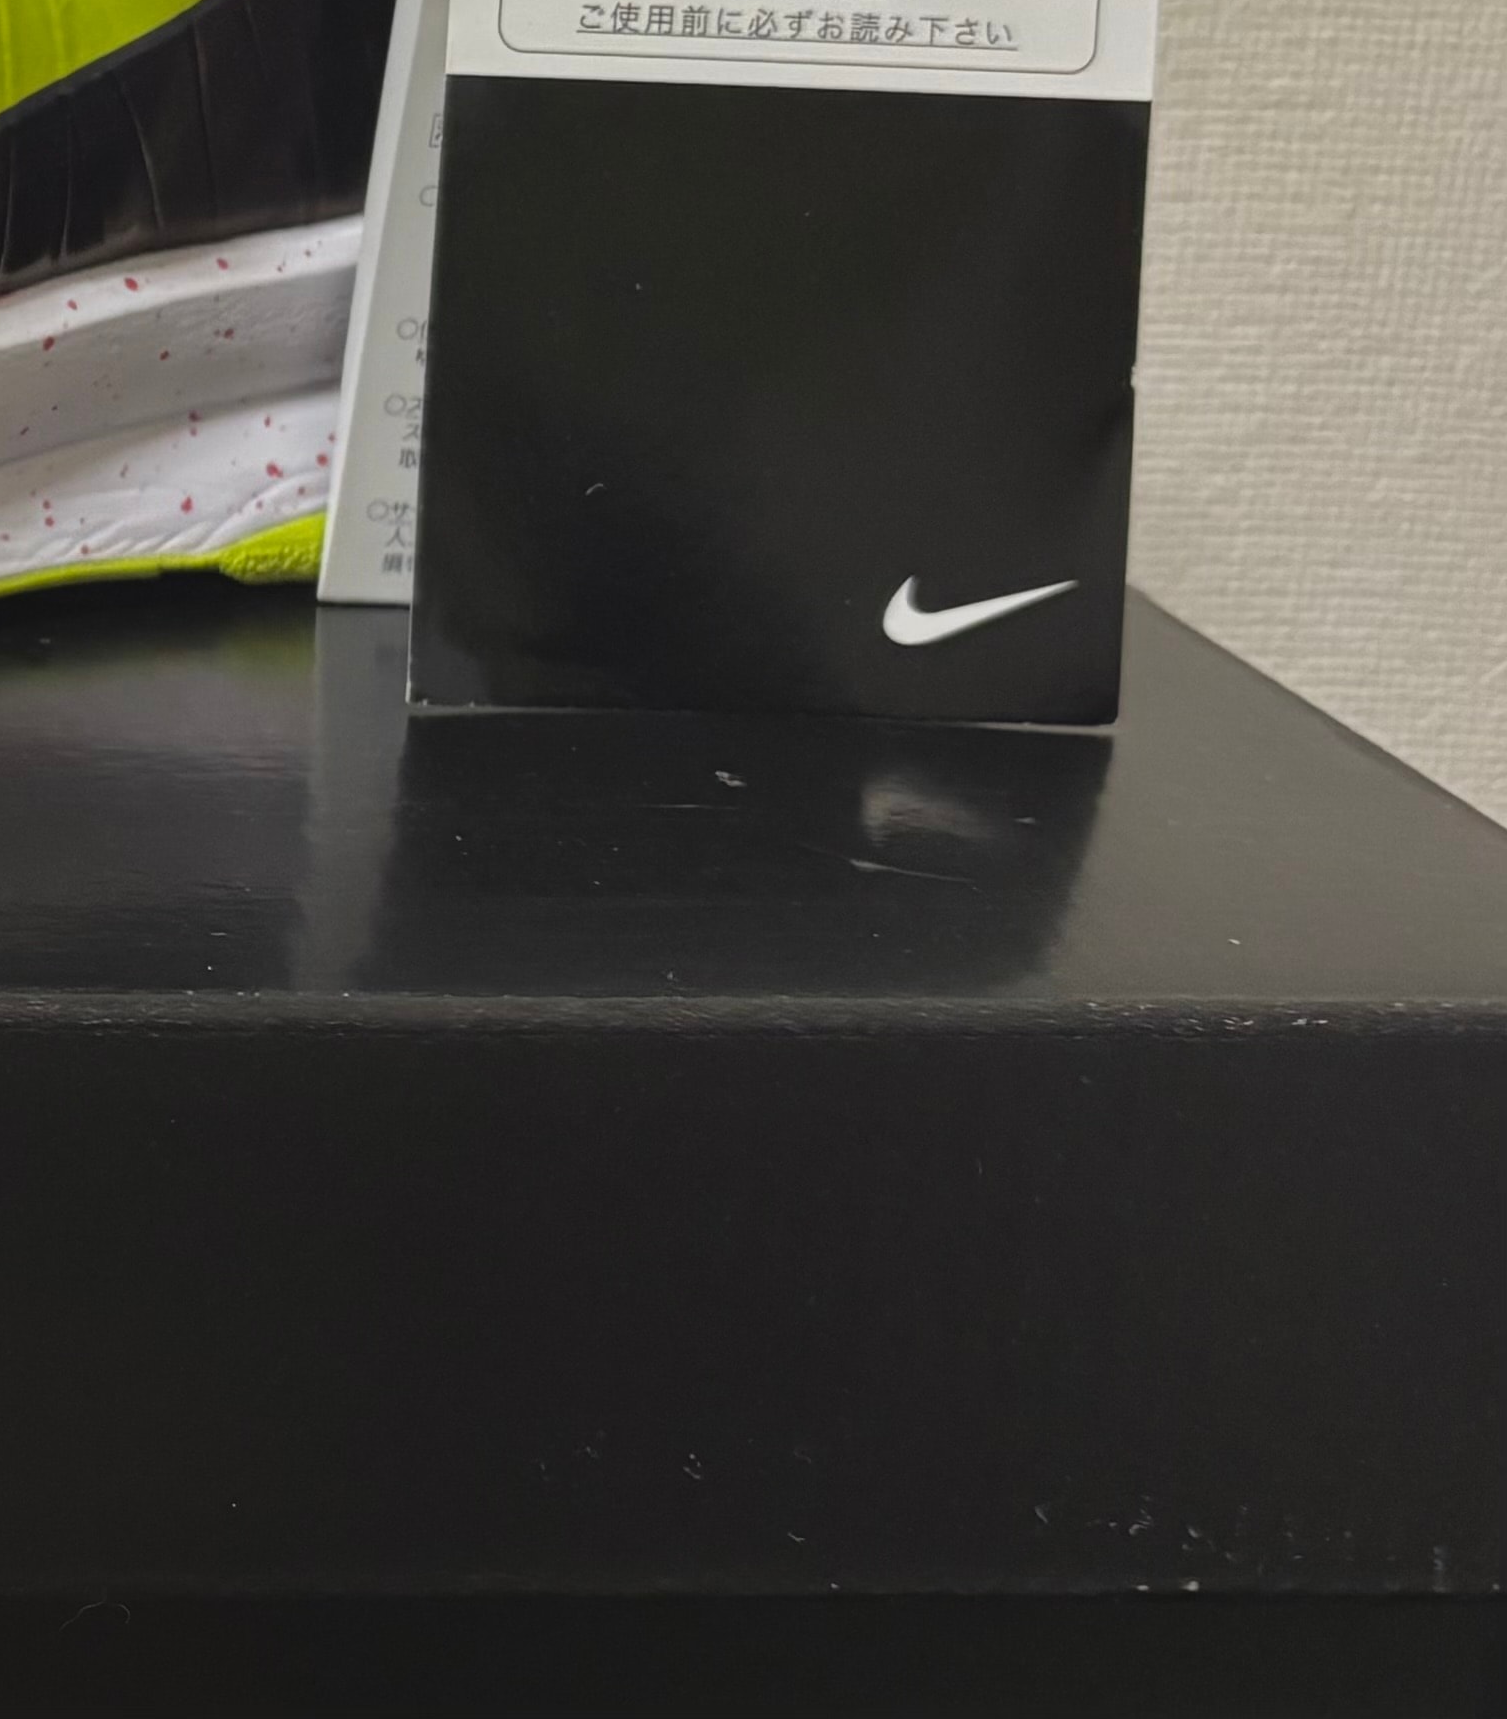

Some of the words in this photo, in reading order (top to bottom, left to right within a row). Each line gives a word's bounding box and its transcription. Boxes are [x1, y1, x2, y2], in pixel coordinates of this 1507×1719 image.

[577, 1, 1013, 47] ご使用前に必ずお読み下さい
